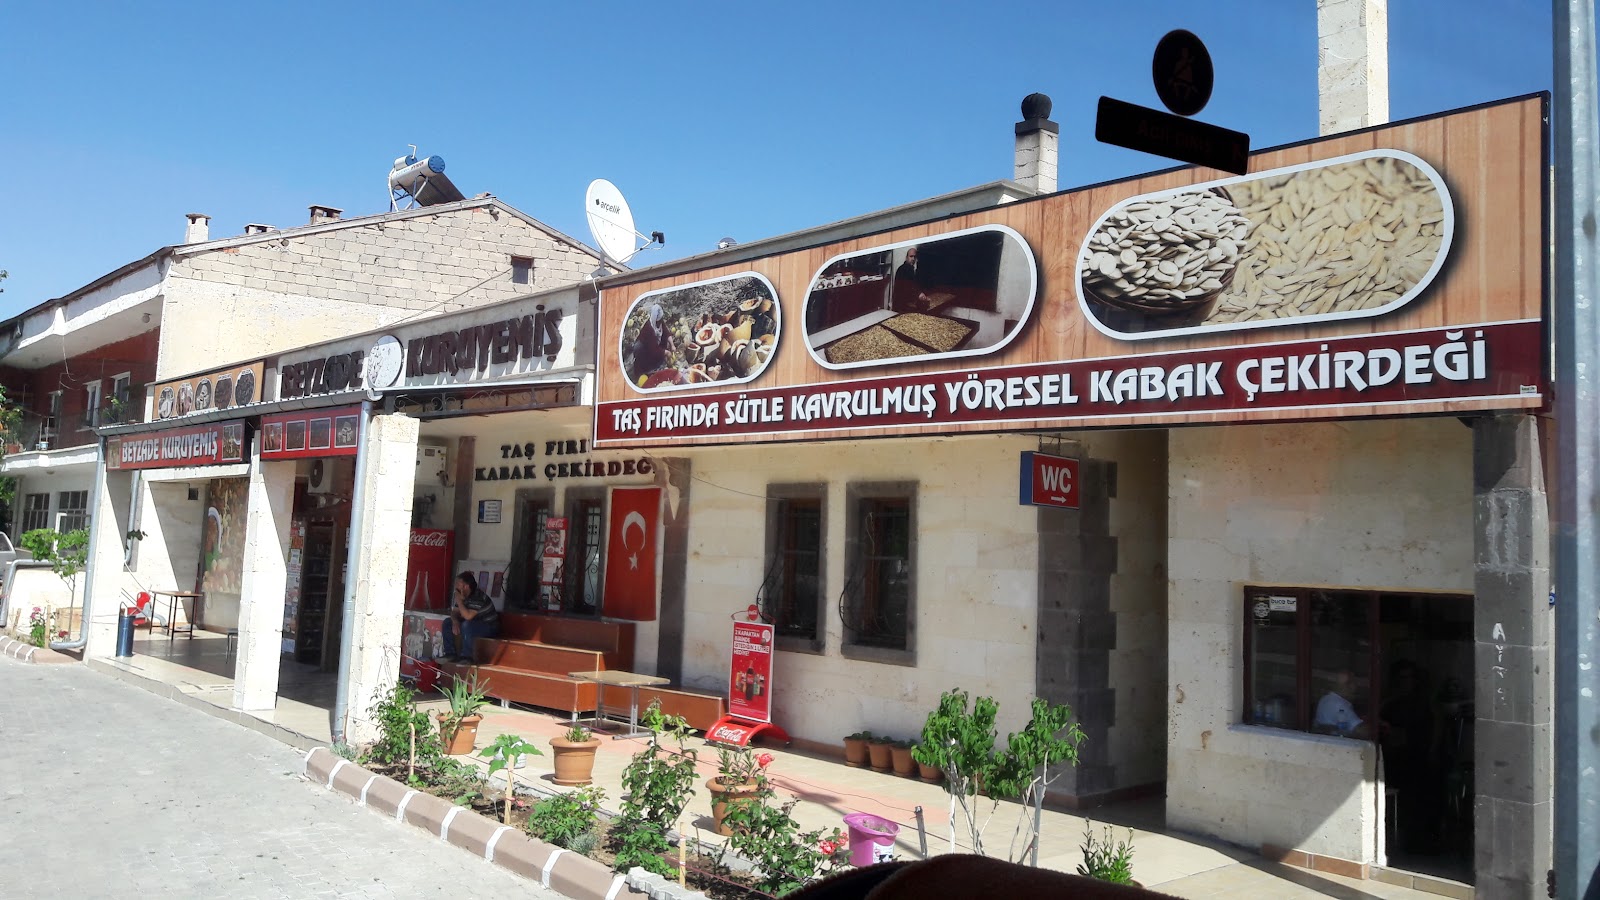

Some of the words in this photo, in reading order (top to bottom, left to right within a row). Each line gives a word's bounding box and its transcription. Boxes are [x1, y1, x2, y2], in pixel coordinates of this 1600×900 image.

[600, 201, 620, 214] arçelik
[405, 304, 563, 378] KURUYEMİŞ
[612, 408, 641, 434] TAŞ
[646, 402, 720, 431] FIRINDA
[725, 394, 784, 425] SÜTLE
[790, 383, 938, 421] KAVRULMUŞ
[944, 372, 1079, 414] YÖRESEL
[1090, 360, 1224, 406] KABAK
[1236, 330, 1488, 402] ÇEKİRDEĞİ
[122, 439, 160, 463] BEYZADE
[161, 427, 218, 462] KURUYEMİŞ
[500, 442, 536, 460] TAŞ
[544, 438, 591, 456] FIRI
[474, 464, 537, 481] KABAK
[1041, 464, 1072, 494] WC
